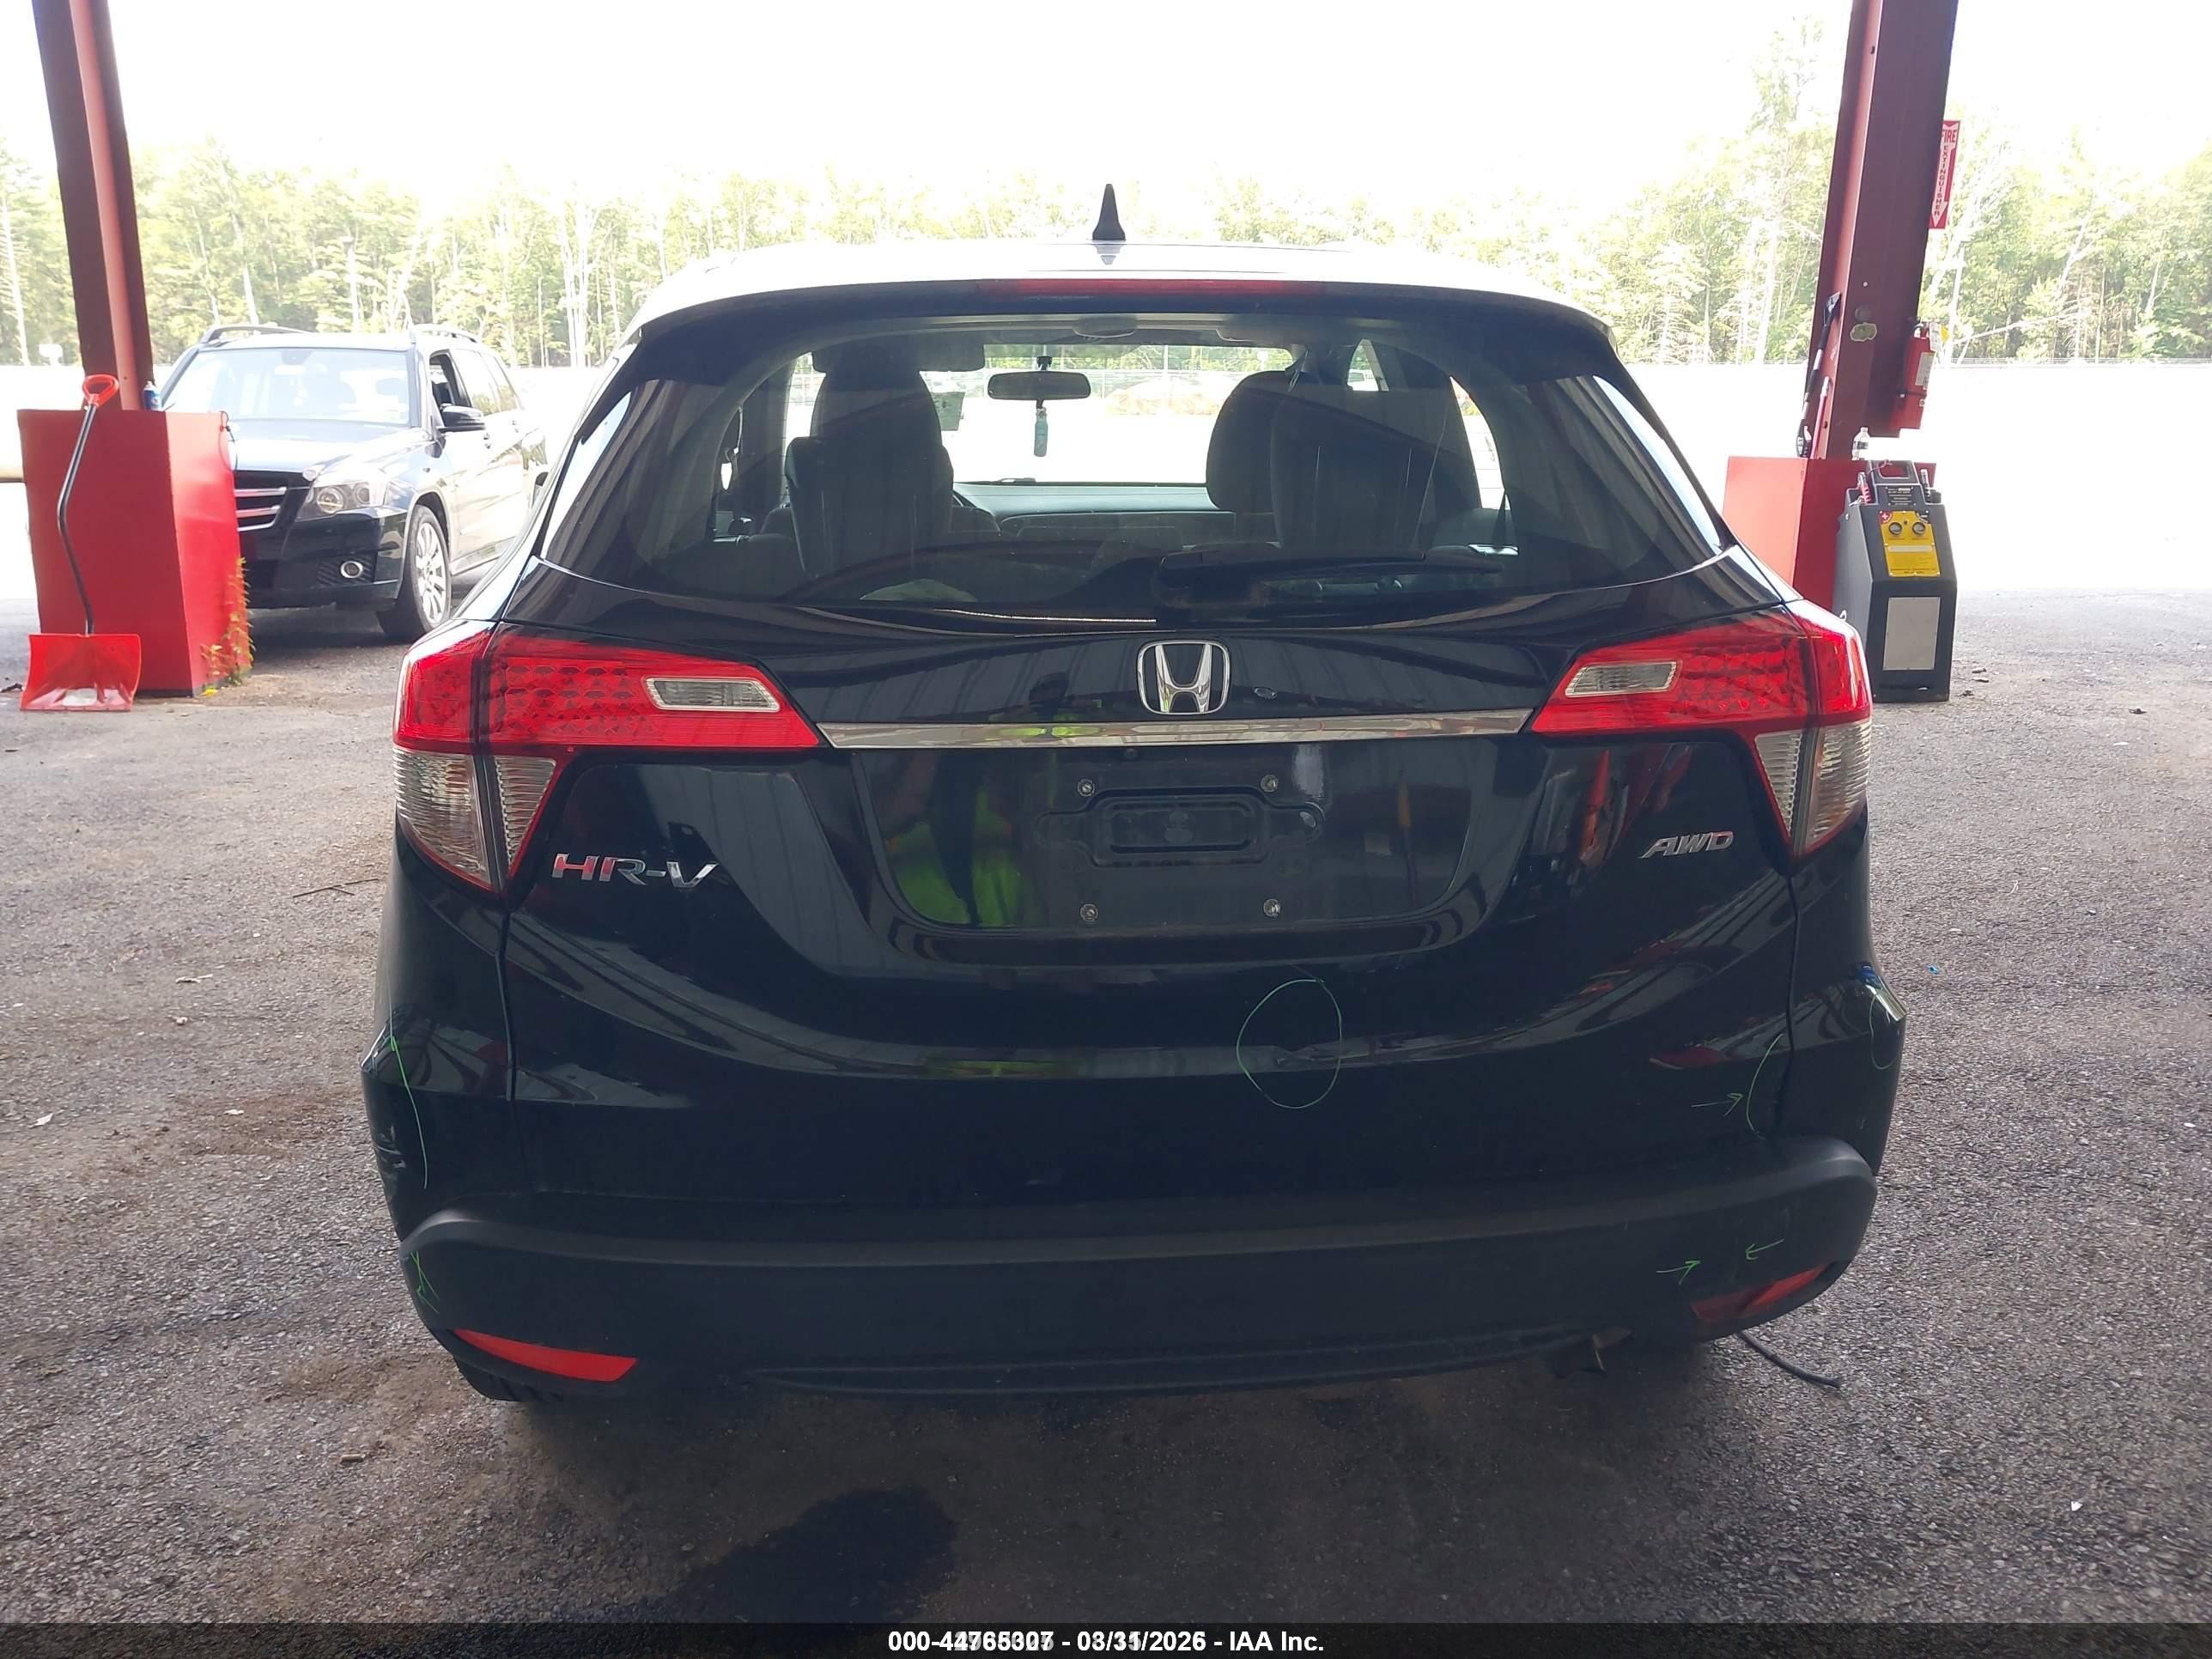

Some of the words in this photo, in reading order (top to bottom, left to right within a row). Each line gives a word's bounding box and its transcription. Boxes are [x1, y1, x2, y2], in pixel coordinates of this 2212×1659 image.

[1934, 144, 1949, 216] EXTINGUISHER
[1638, 830, 1735, 859] AWD
[551, 852, 720, 889] HR-V
